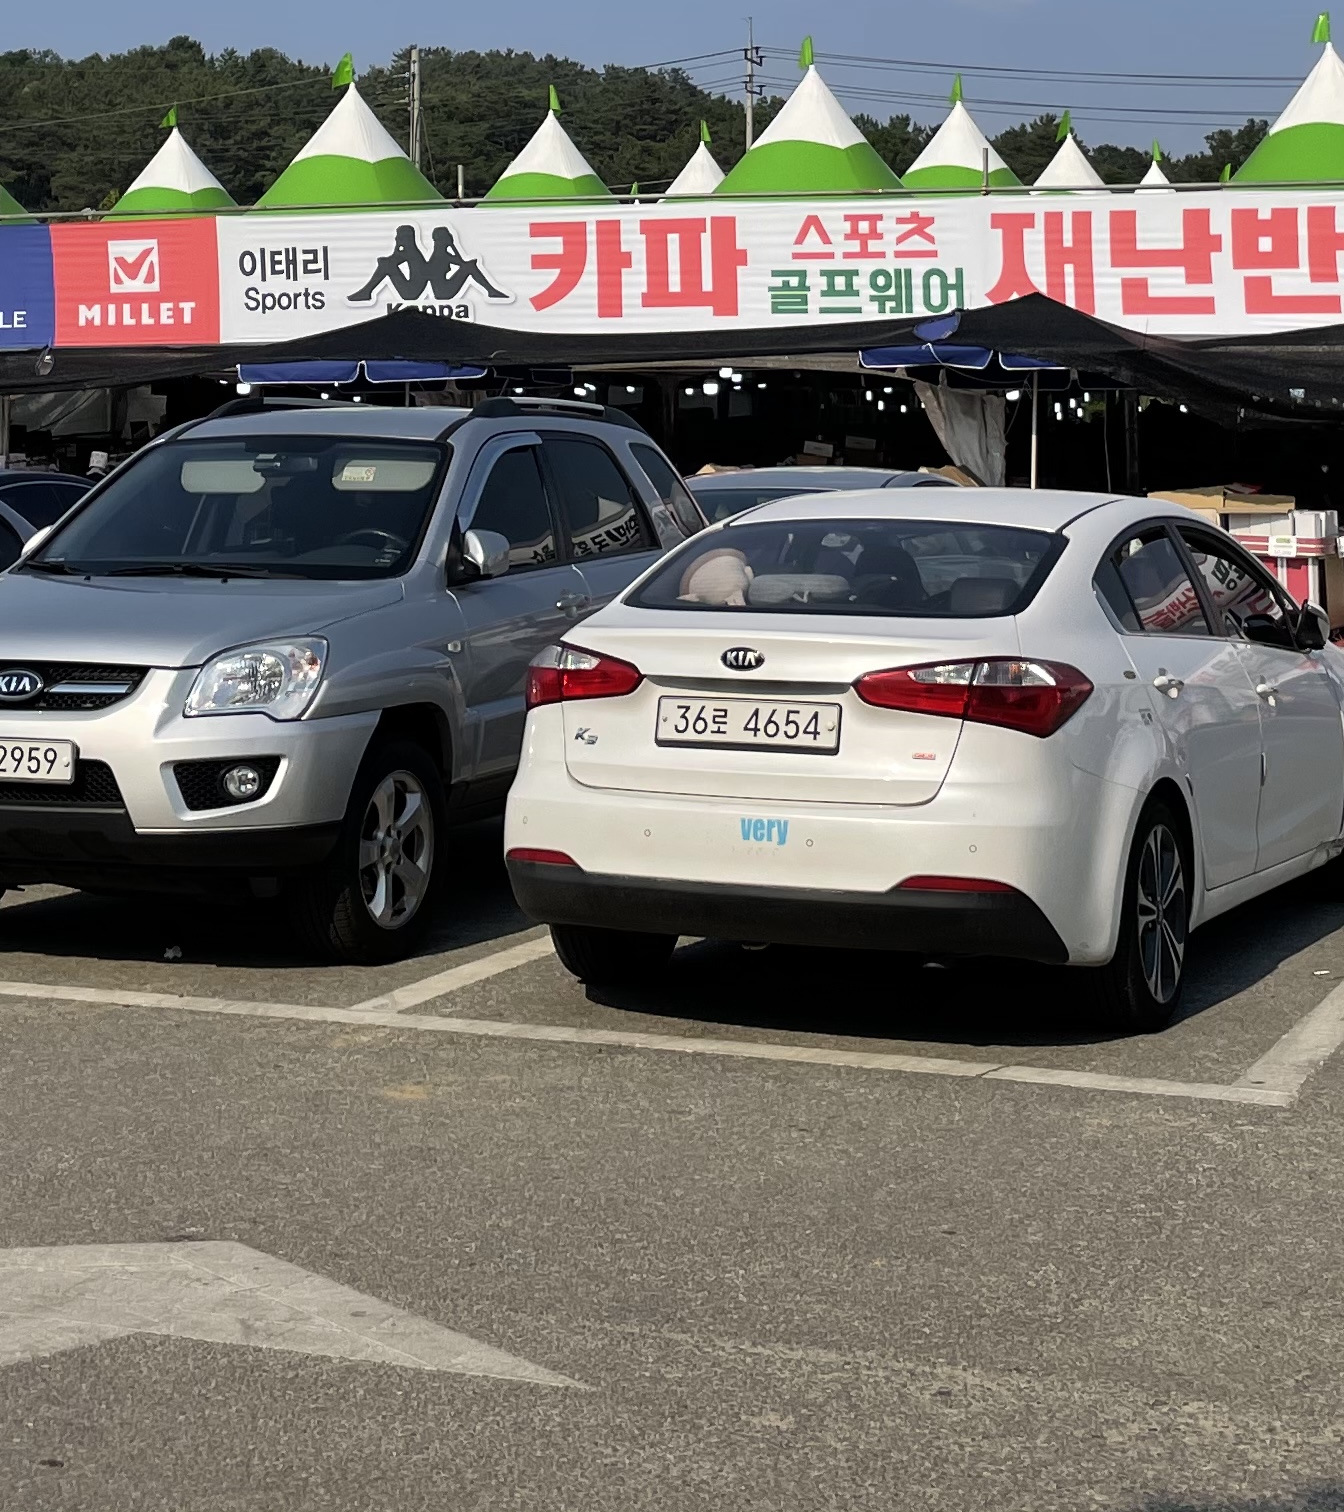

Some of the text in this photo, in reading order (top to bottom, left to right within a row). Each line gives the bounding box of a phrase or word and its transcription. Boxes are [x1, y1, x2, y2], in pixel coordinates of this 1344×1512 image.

[791, 211, 938, 259] 스포츠
[238, 245, 330, 282] 이태리
[528, 215, 748, 318] 카파
[244, 287, 325, 314] Sports
[767, 266, 964, 314] 골프웨어
[78, 301, 196, 326] MILLET
[386, 301, 470, 319] Kppa
[725, 651, 757, 666] KIA
[574, 727, 599, 745] K3
[673, 704, 821, 741] 36로 4654
[740, 817, 789, 846] very
